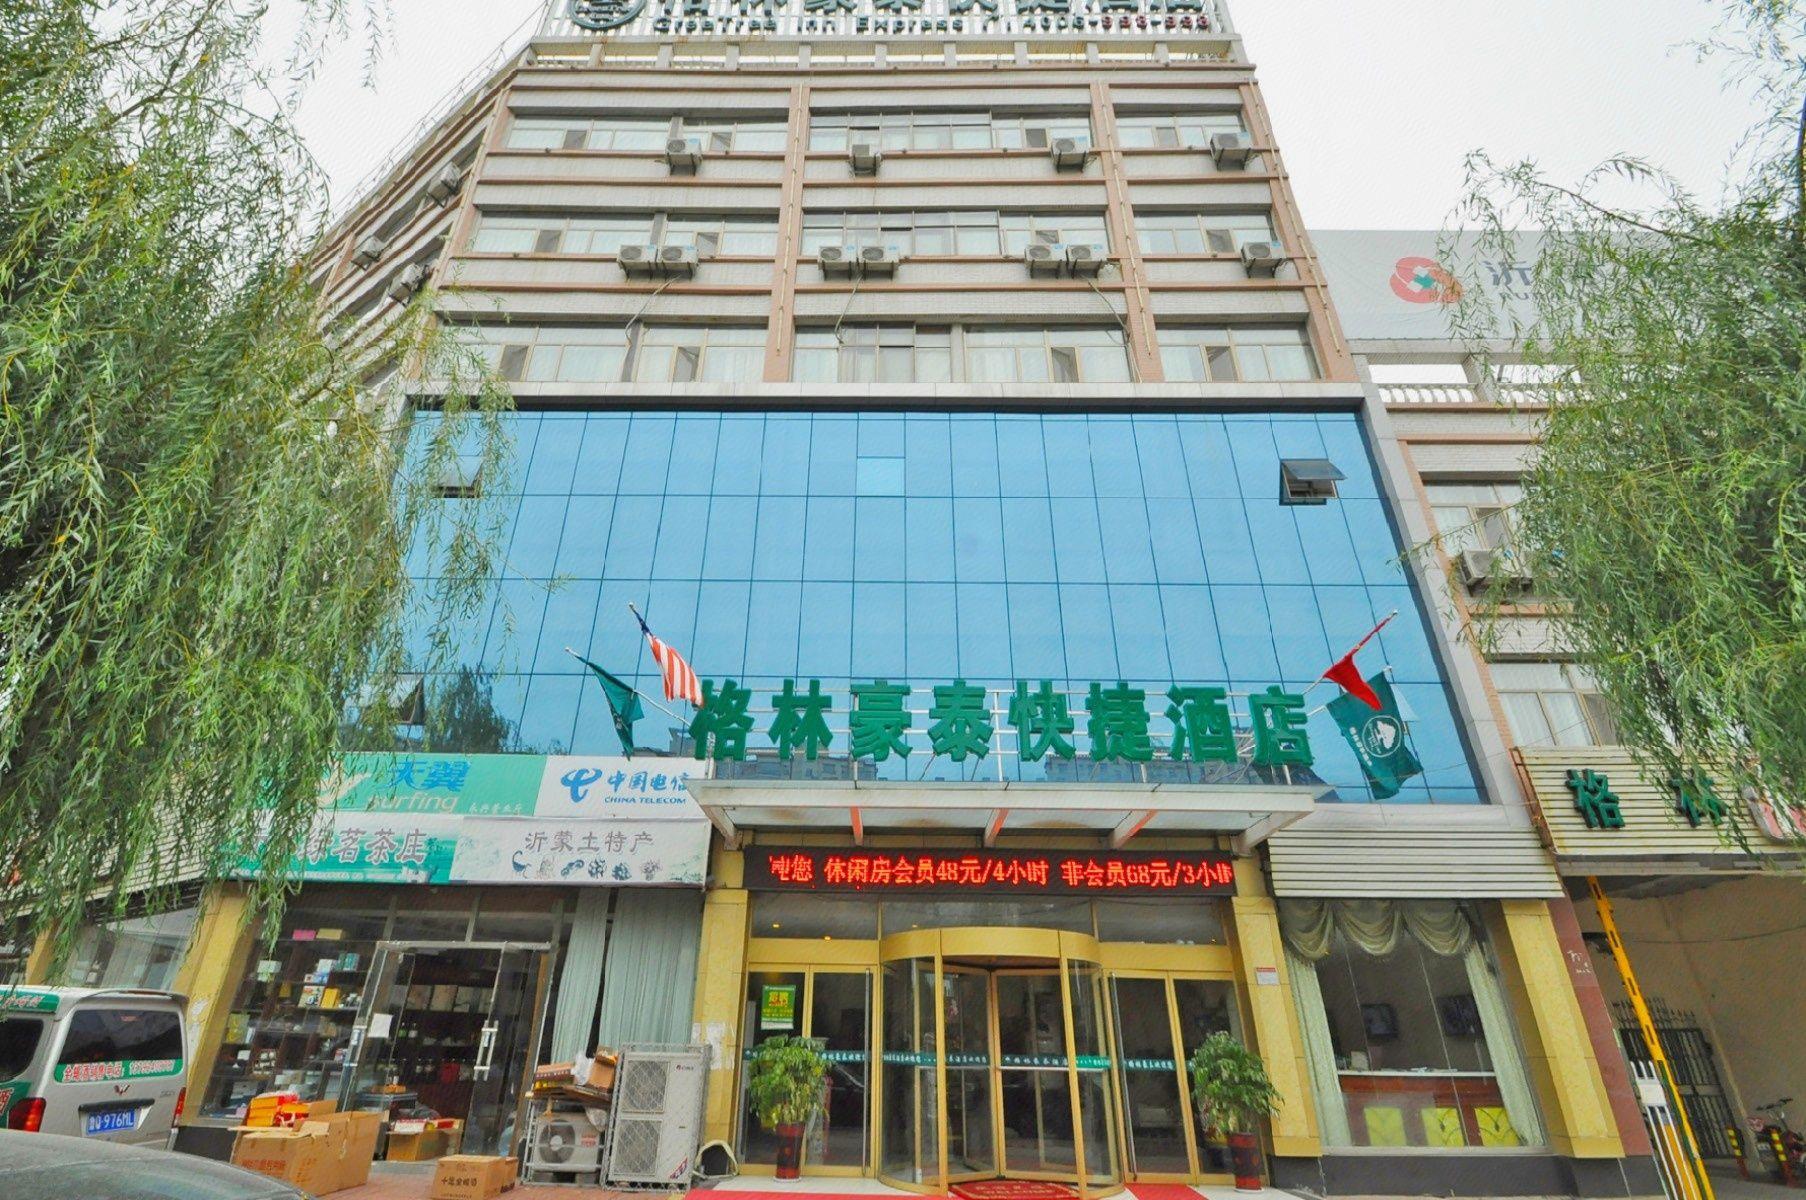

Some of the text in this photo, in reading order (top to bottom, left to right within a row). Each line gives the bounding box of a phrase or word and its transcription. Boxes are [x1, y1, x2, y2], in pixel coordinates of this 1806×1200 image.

[856, 16, 963, 33] Express
[689, 678, 1314, 767] 格林豪泰快捷酒店
[388, 759, 471, 792] 天翼
[604, 796, 687, 805] CHINA TELECOM
[525, 830, 655, 855] 沂蒙土特产
[823, 856, 1049, 885] 休闲房会员48元/4小时
